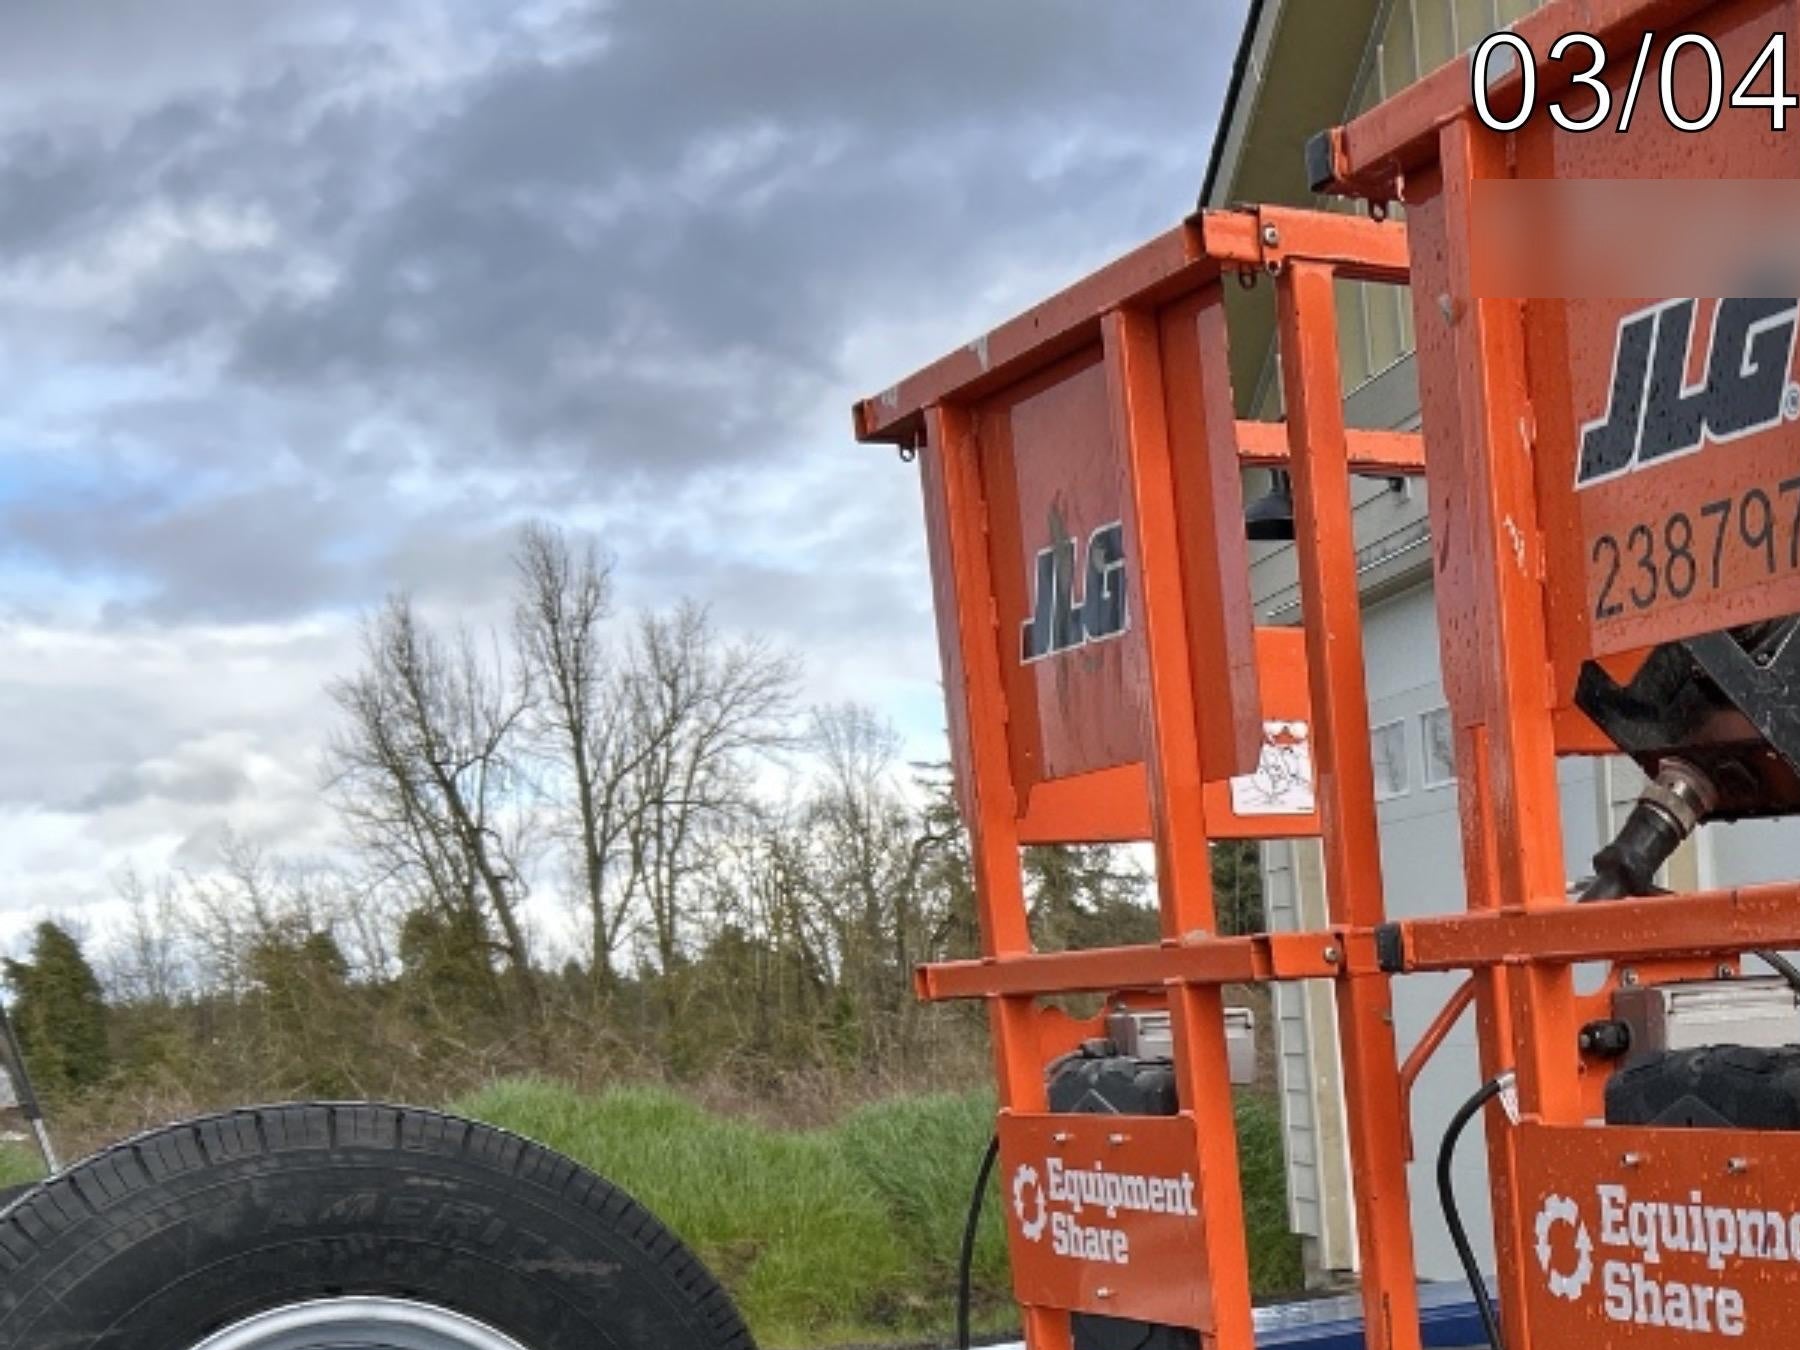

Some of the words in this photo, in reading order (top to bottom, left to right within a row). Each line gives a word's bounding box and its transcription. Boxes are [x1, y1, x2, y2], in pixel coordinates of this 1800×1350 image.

[1020, 521, 1127, 664] JLG
[1047, 1157, 1199, 1219] Equipment
[1052, 1213, 1129, 1265] Share
[1602, 1259, 1745, 1337] Share
